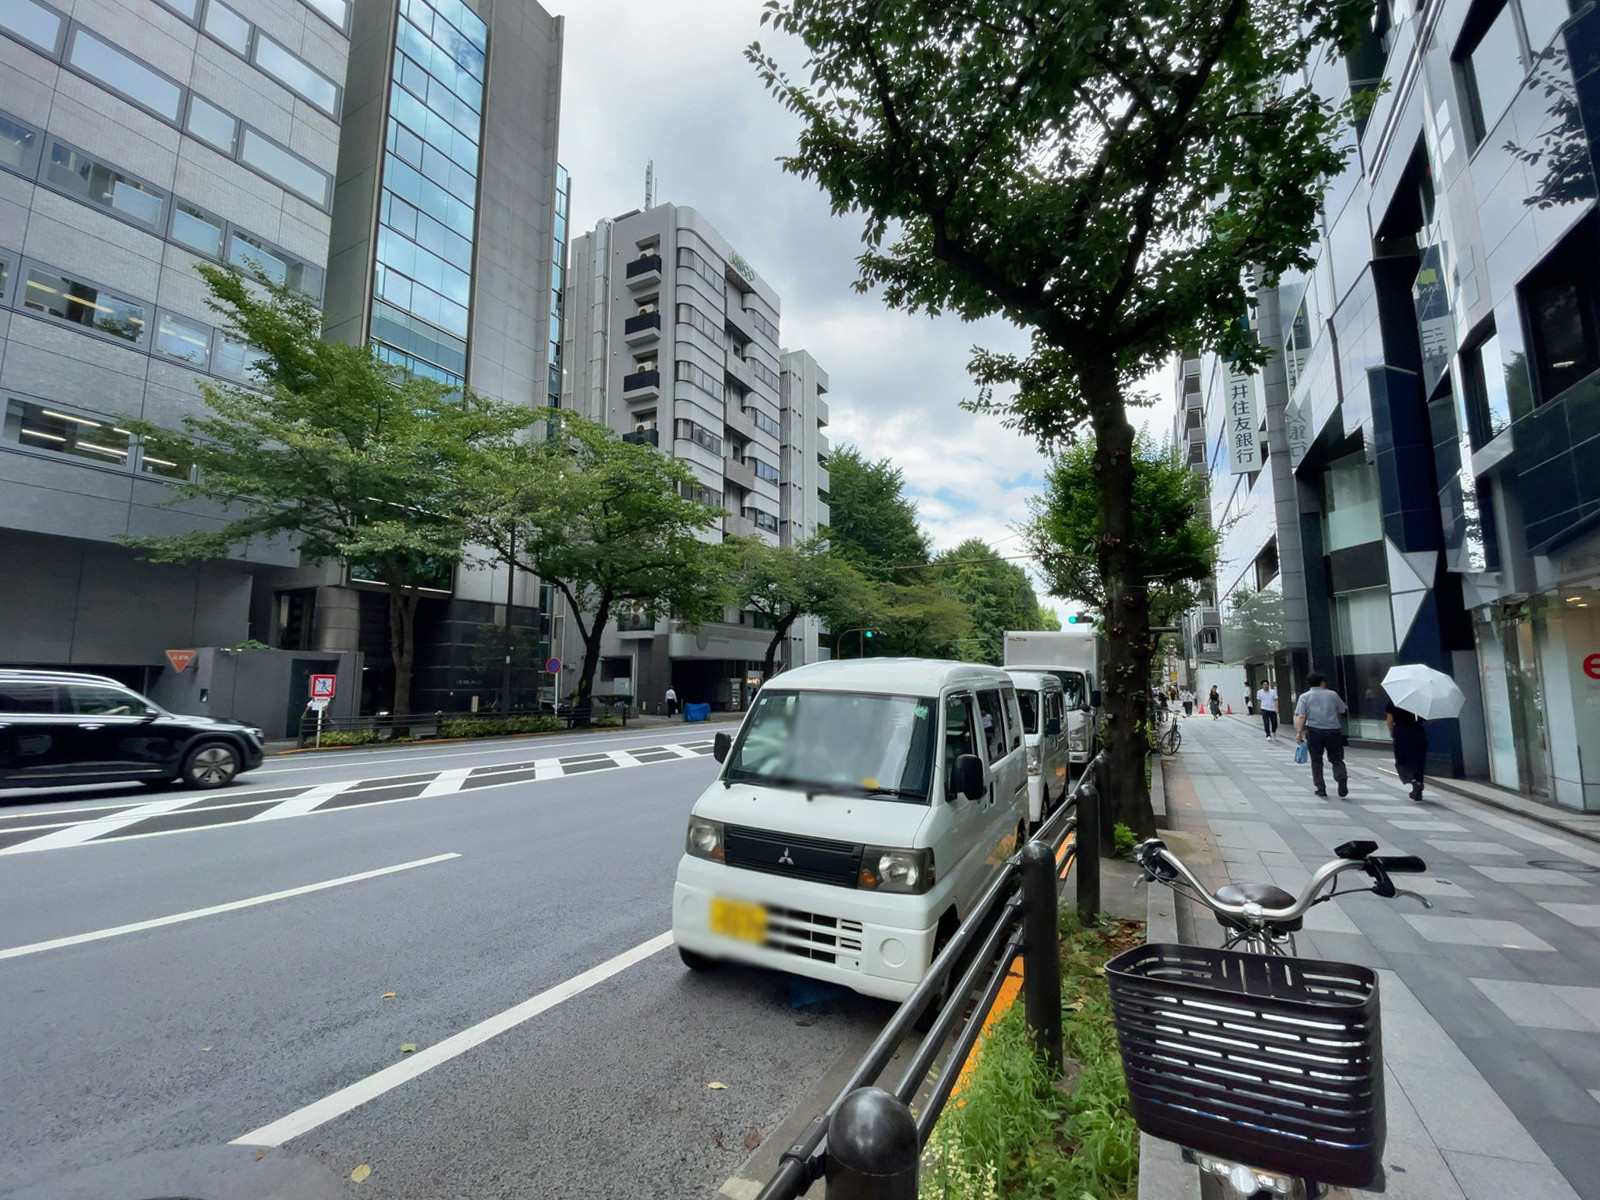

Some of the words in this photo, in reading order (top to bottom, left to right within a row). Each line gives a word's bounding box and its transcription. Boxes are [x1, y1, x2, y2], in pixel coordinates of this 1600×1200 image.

[1230, 373, 1255, 464] 三井住友銀行
